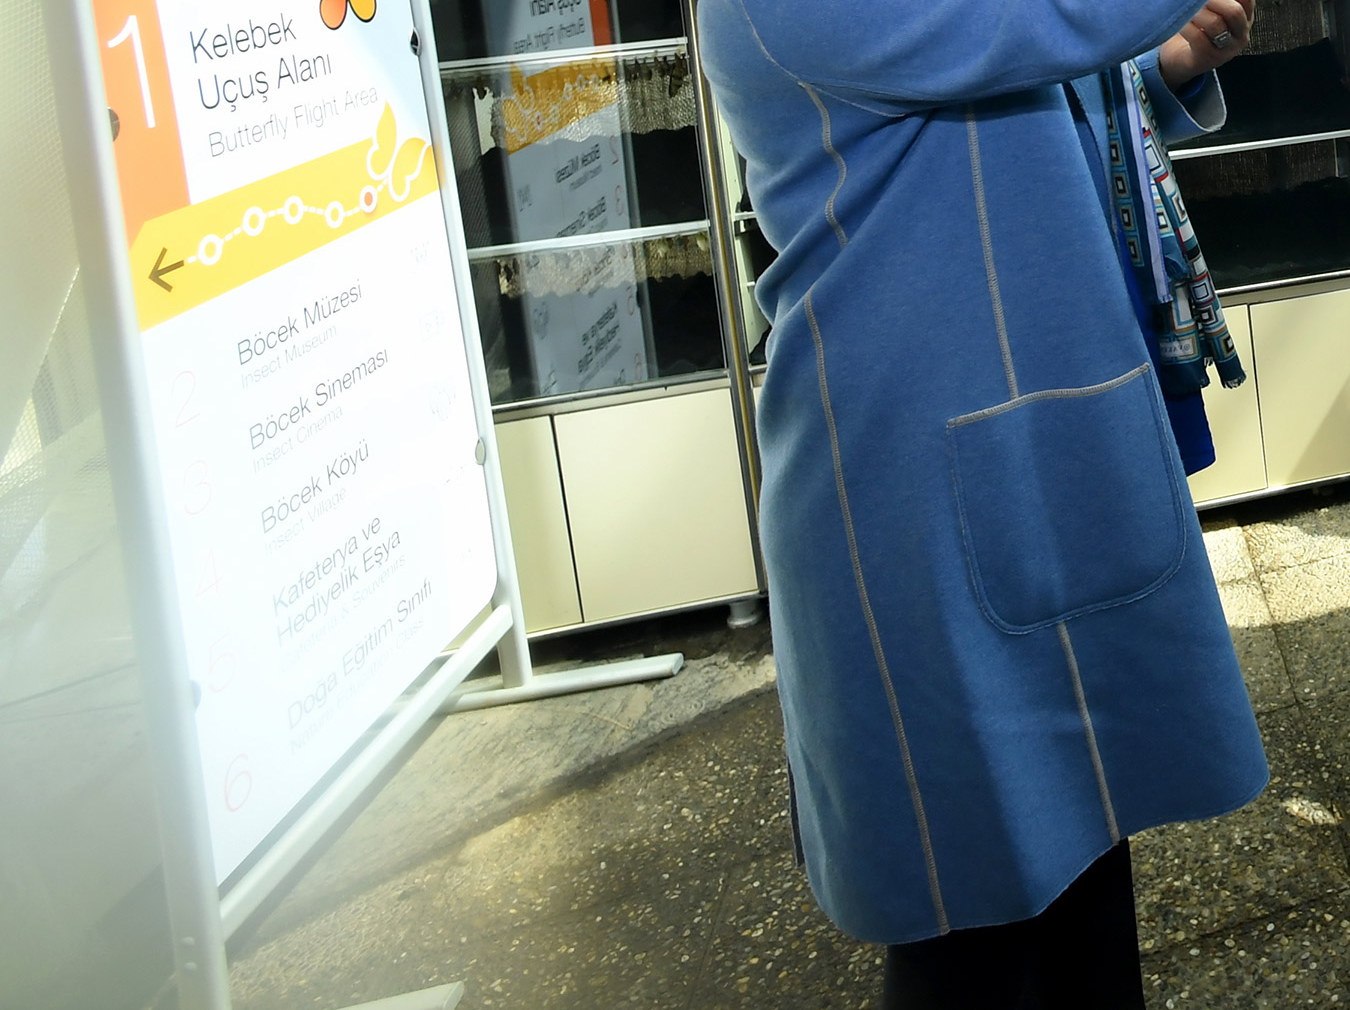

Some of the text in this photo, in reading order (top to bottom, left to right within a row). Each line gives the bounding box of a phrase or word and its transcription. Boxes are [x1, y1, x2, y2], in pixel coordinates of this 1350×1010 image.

[108, 14, 156, 128] 1
[189, 12, 298, 64] Kelebek
[198, 54, 332, 113] Uçuş Alanı
[208, 87, 379, 158] Butterfly Flight Area
[237, 278, 362, 366] Böcek Müzesi
[240, 325, 338, 390] Insect Museum
[249, 349, 389, 450] Böcek Sineması
[253, 405, 343, 474] Insect Cinema
[261, 438, 369, 534] Böcek Köyü
[272, 517, 381, 618] Kafeterya ve
[277, 531, 401, 647] Hediyelik Eşya
[287, 671, 338, 731] Doğa
[342, 618, 394, 676] Eğitim
[224, 752, 253, 813] 6
